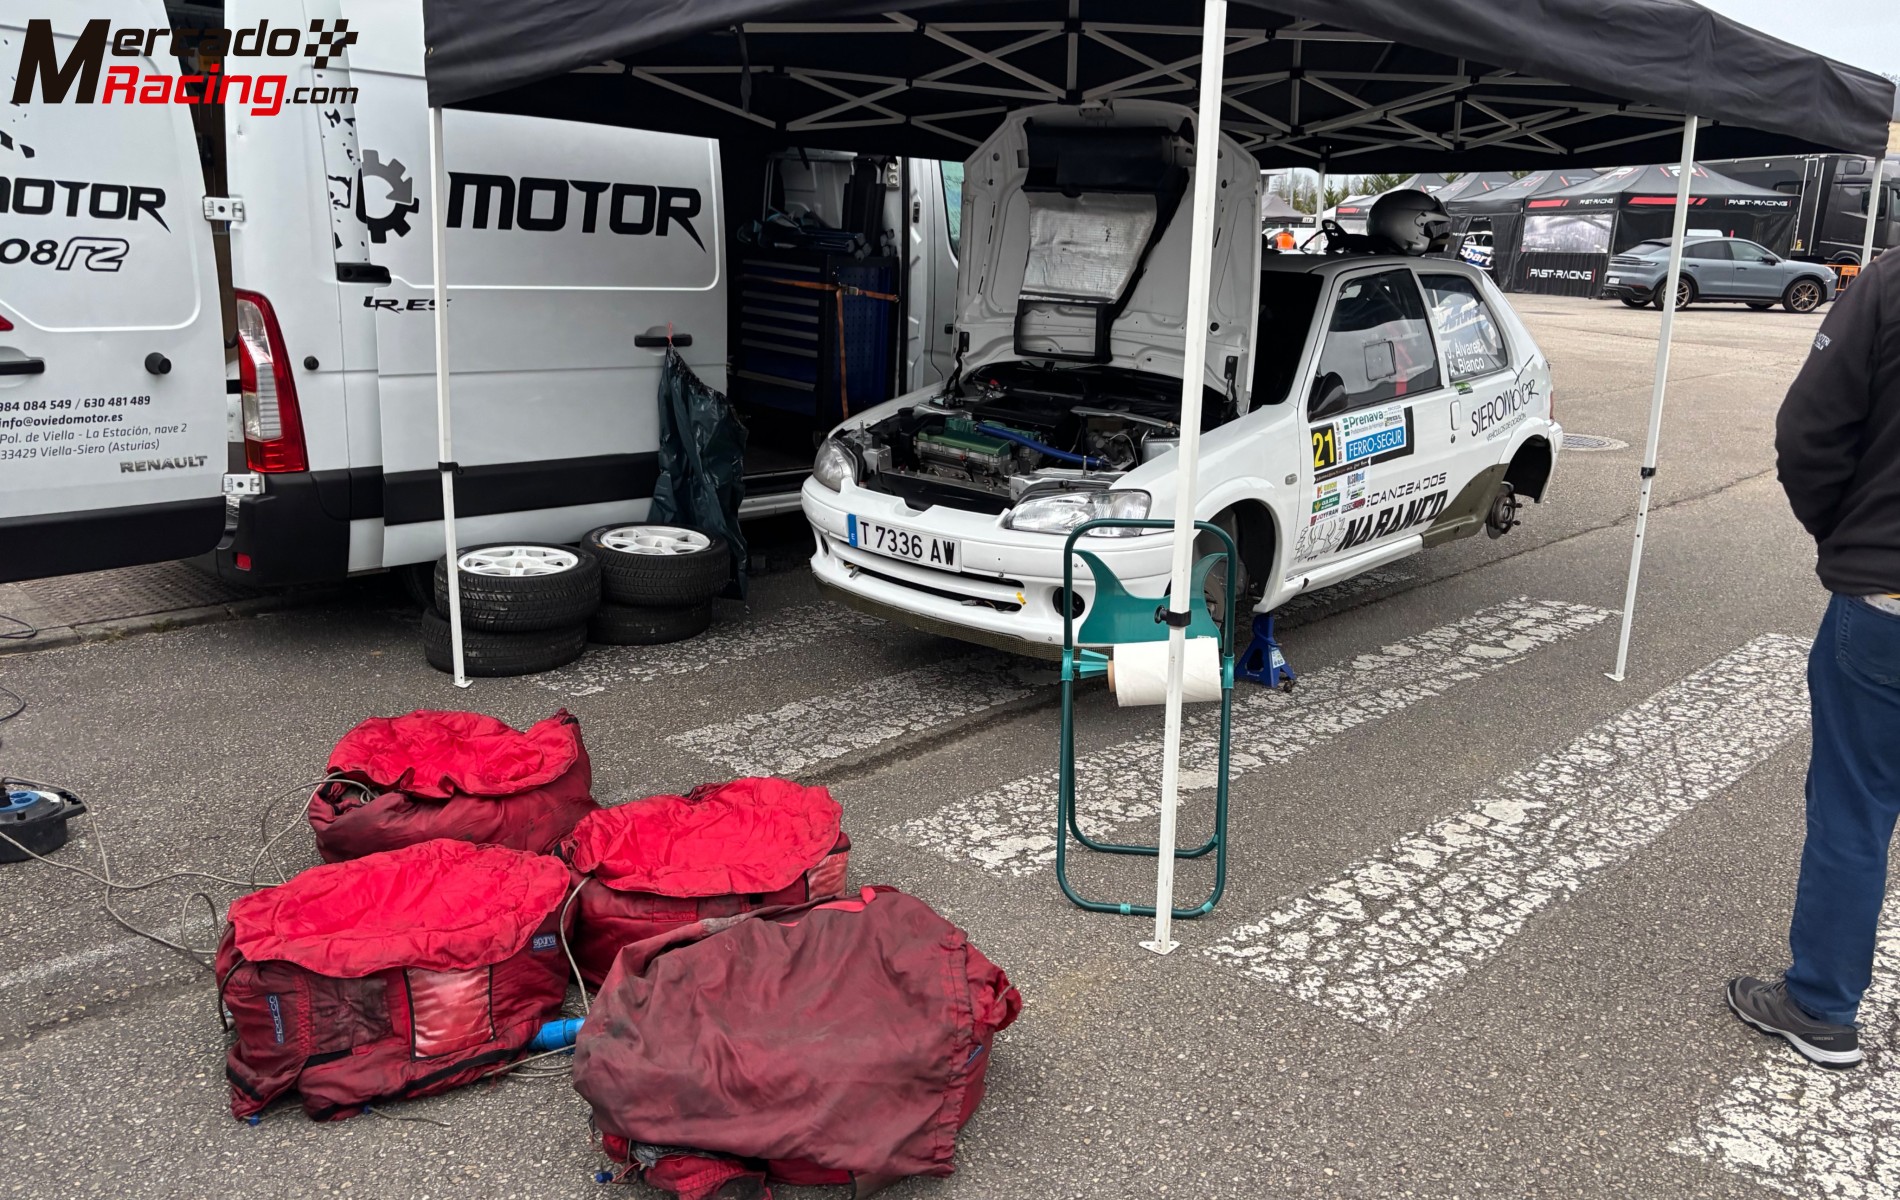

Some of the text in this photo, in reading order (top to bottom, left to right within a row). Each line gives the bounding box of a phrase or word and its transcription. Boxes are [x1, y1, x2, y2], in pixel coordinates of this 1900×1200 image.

[0, 177, 171, 234] OTOR
[446, 171, 707, 253] MOTOR
[1450, 357, 1485, 376] A. Blanco
[23, 400, 47, 411] 084
[50, 399, 72, 410] 549
[84, 398, 105, 409] 630
[108, 397, 127, 407] 481
[130, 395, 151, 406] 489
[0, 414, 123, 430] info@oviedomotor.es
[1348, 410, 1384, 428] Prenava
[0, 432, 22, 444] Pol.
[25, 432, 40, 443] de
[43, 430, 75, 442] Viella
[86, 428, 100, 439] La
[102, 425, 151, 438] Estación,
[154, 425, 179, 435] nave
[181, 423, 187, 433] 2
[1348, 429, 1403, 459] FERRO-SEGUR
[0, 439, 160, 460] 33429 Viella-Siero (Asturias)
[1312, 429, 1334, 468] 21
[119, 455, 208, 473] RENAULT
[860, 521, 955, 566] T 7336 AW
